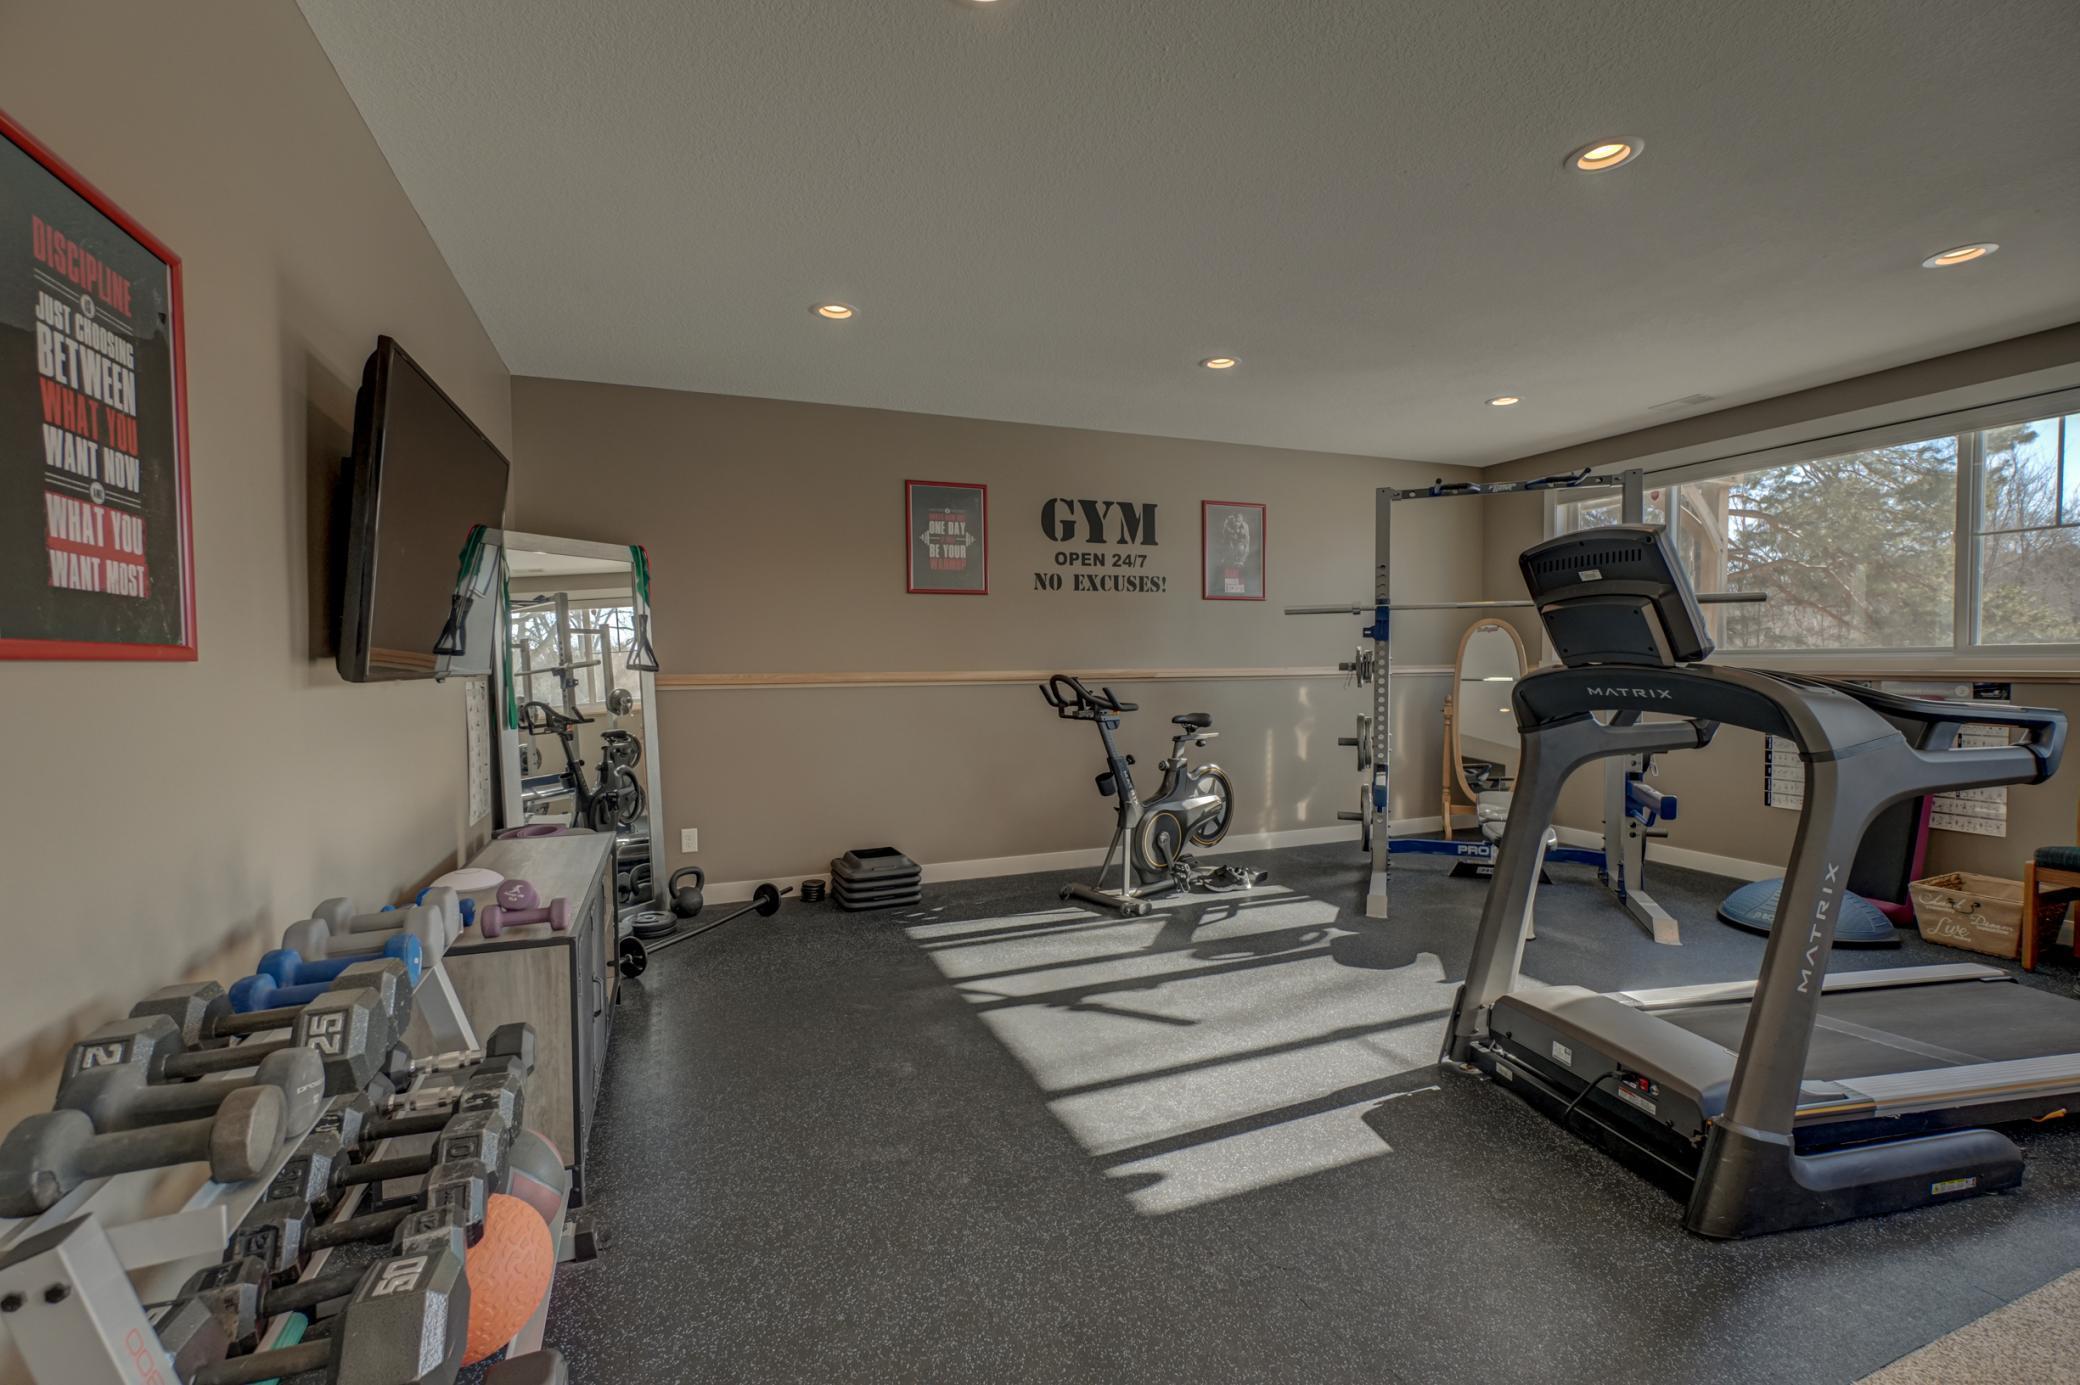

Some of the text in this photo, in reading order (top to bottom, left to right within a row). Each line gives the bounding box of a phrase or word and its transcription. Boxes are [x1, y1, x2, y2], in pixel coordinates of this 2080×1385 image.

[32, 213, 132, 319] DISCIPLINE
[35, 290, 135, 370] JUST CHOOSING
[36, 320, 137, 417] BETWEEN
[39, 377, 139, 456] WHAT YOU
[42, 423, 140, 493] WANT NOW
[45, 492, 143, 556] WHAT YOU
[929, 521, 966, 535] ONE DAY
[1041, 498, 1158, 546] GYM
[929, 544, 966, 558] BE YOUR
[1055, 552, 1147, 568] OPEN 24/7
[50, 549, 145, 598] WANT MOST
[1034, 573, 1166, 592] NO EXCUSES!
[1587, 687, 1673, 699] MATRIX
[1457, 845, 1490, 855] PRO
[1797, 862, 1839, 993] MATRIX
[1927, 917, 1970, 937] Live
[307, 1012, 342, 1051] 25
[372, 1256, 428, 1296] 50
